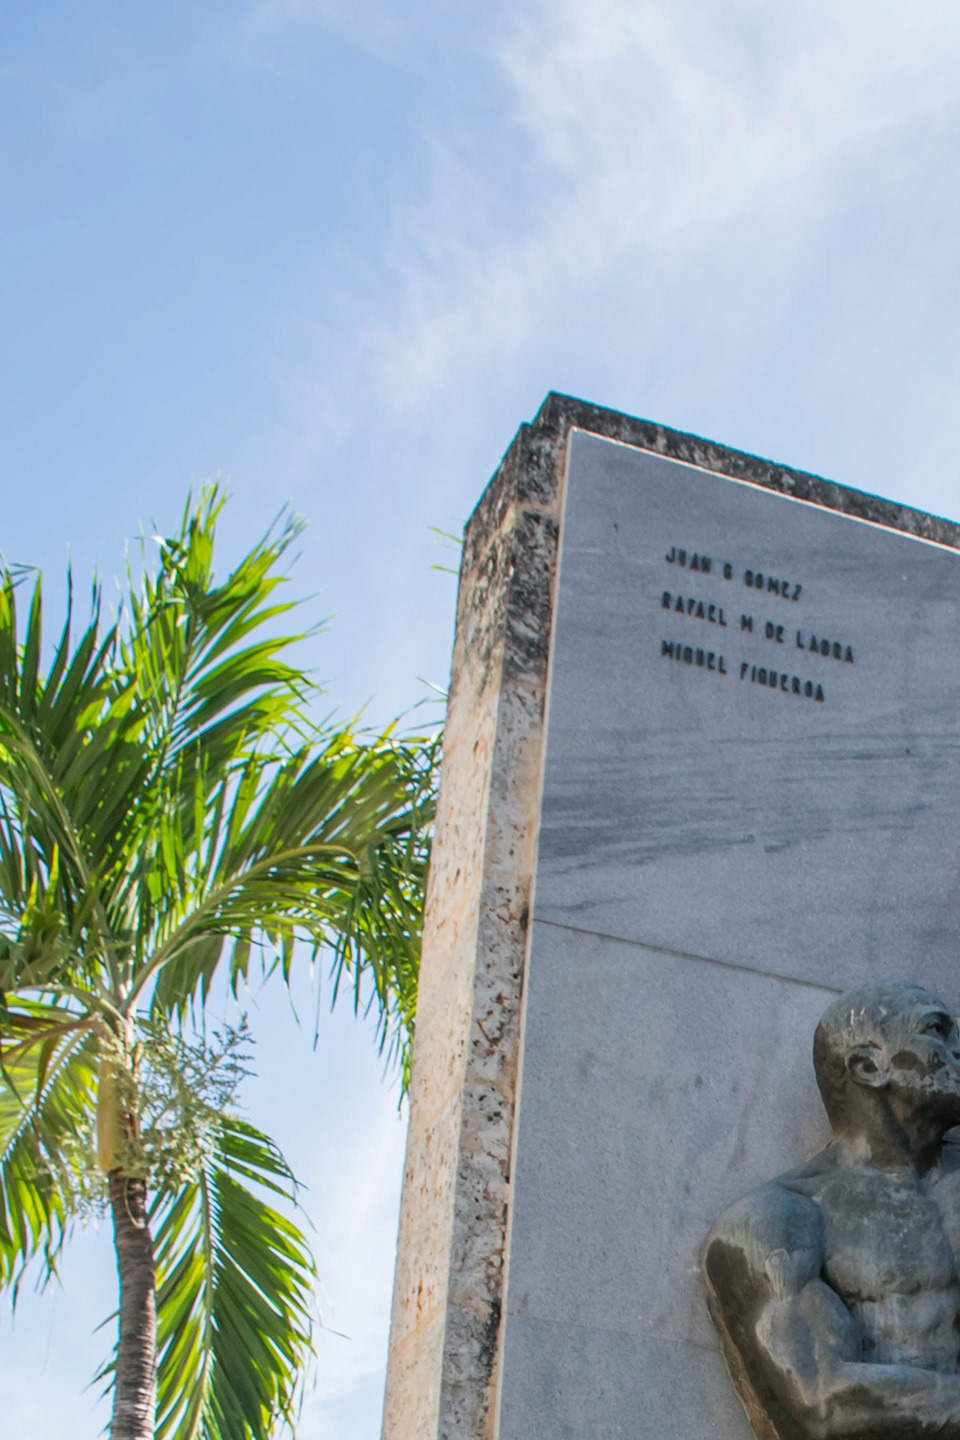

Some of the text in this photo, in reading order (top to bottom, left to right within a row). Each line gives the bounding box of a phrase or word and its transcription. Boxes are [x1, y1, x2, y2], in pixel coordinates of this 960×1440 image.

[665, 546, 711, 573] JUAN
[744, 569, 802, 601] GOMEZ
[661, 591, 727, 627] RAFAEL
[765, 621, 784, 643] DE
[796, 630, 854, 664] LABRA
[661, 639, 825, 702] MIGUEL FIGUEROA
